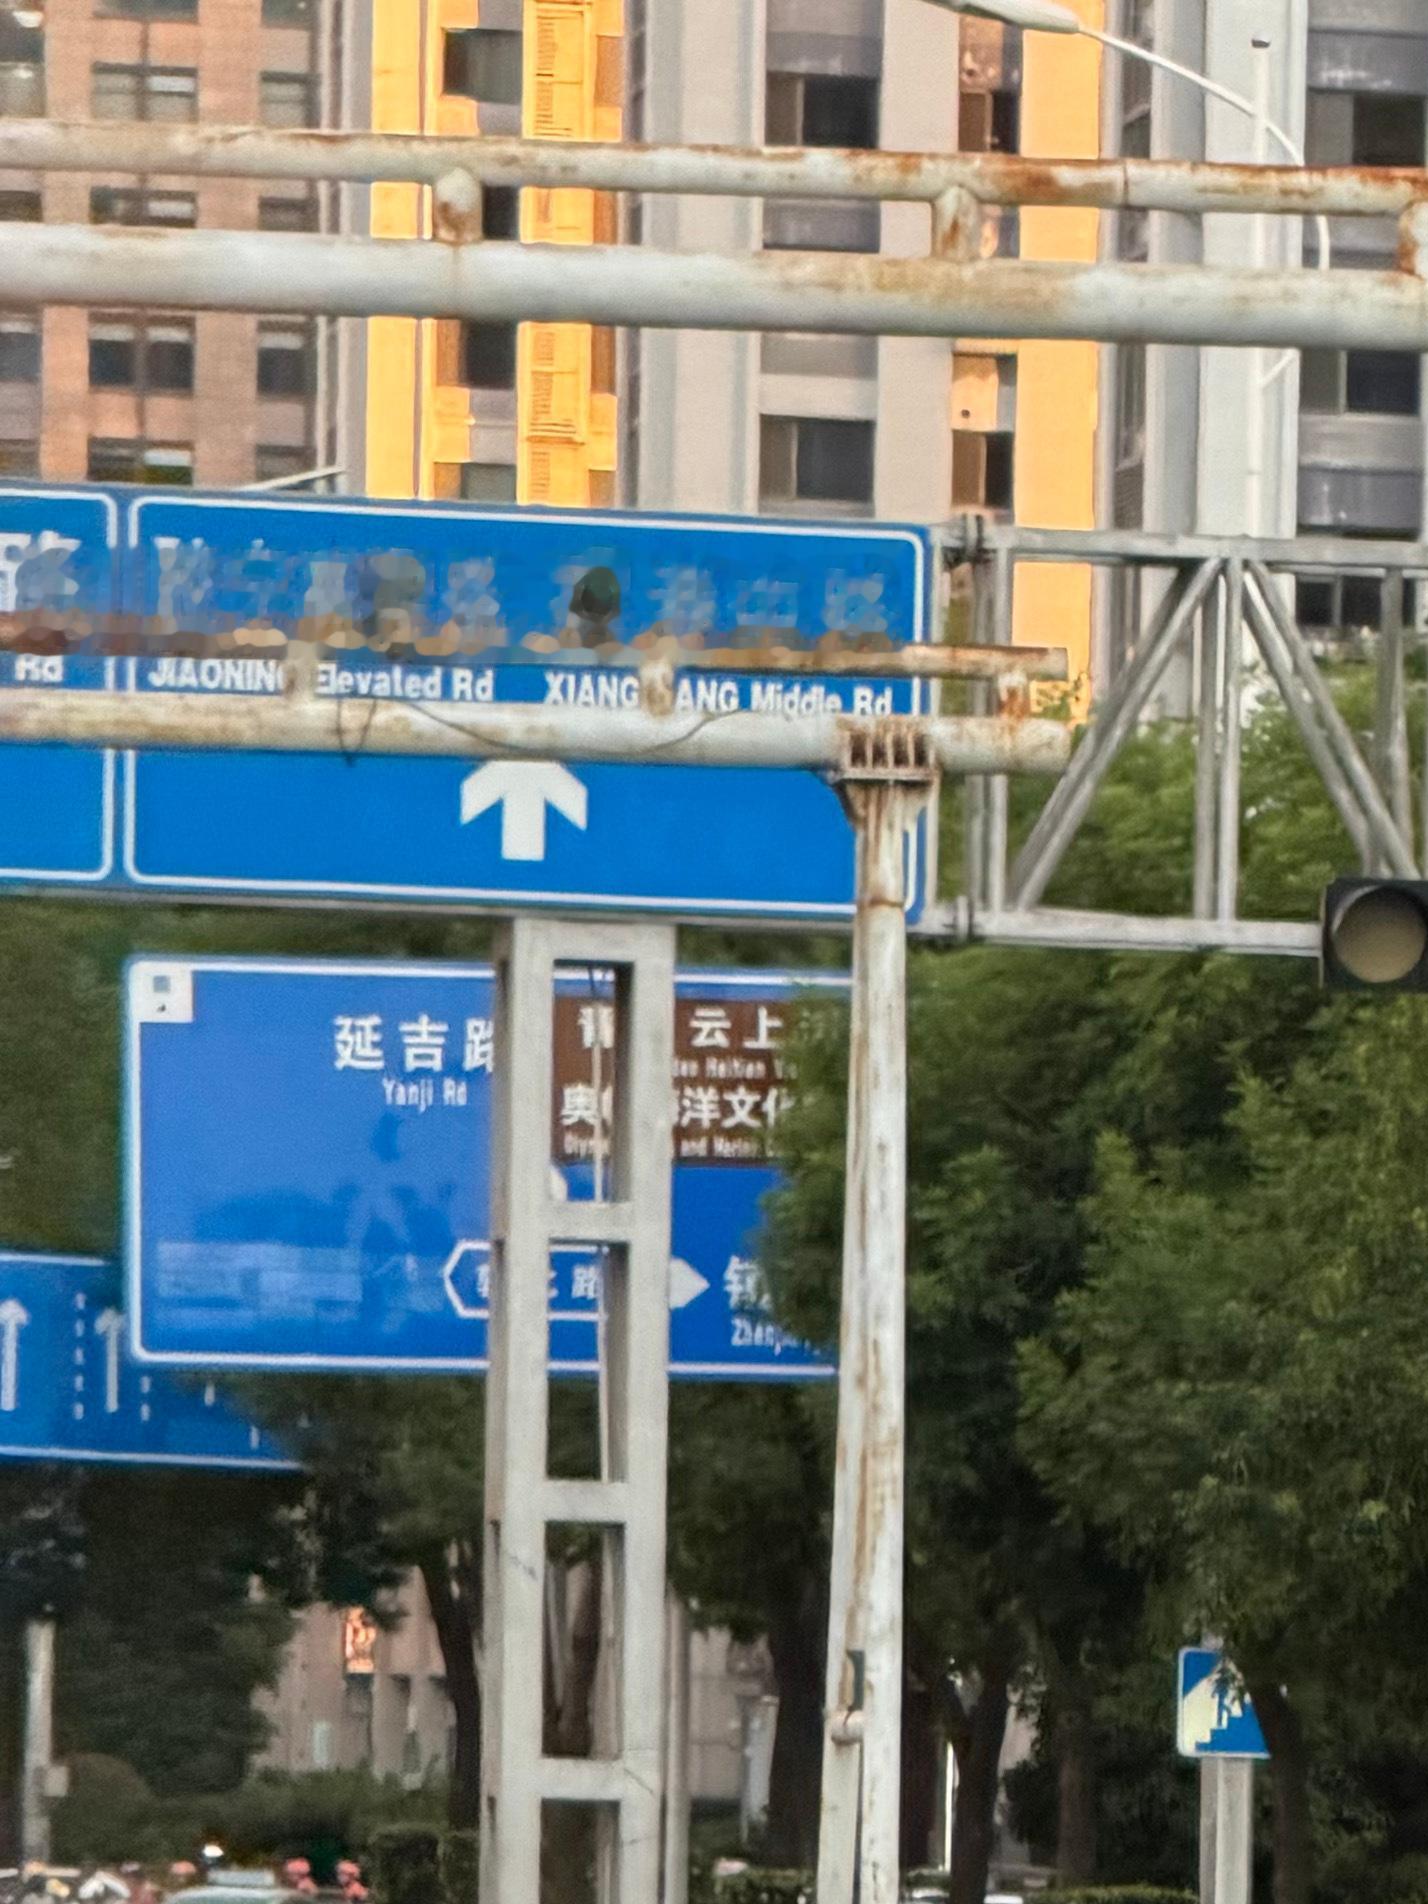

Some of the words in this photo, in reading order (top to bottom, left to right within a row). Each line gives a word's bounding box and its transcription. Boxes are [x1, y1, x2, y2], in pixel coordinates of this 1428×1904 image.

[15, 655, 63, 683] Rd
[148, 658, 288, 693] JIAONIN
[314, 662, 441, 700] Elevated
[452, 669, 494, 702] Rd
[749, 682, 842, 714] Middle
[853, 686, 892, 715] Rd
[334, 1013, 496, 1073] 延吉路
[382, 1075, 434, 1114] Yanji
[443, 1076, 468, 1106] Rd
